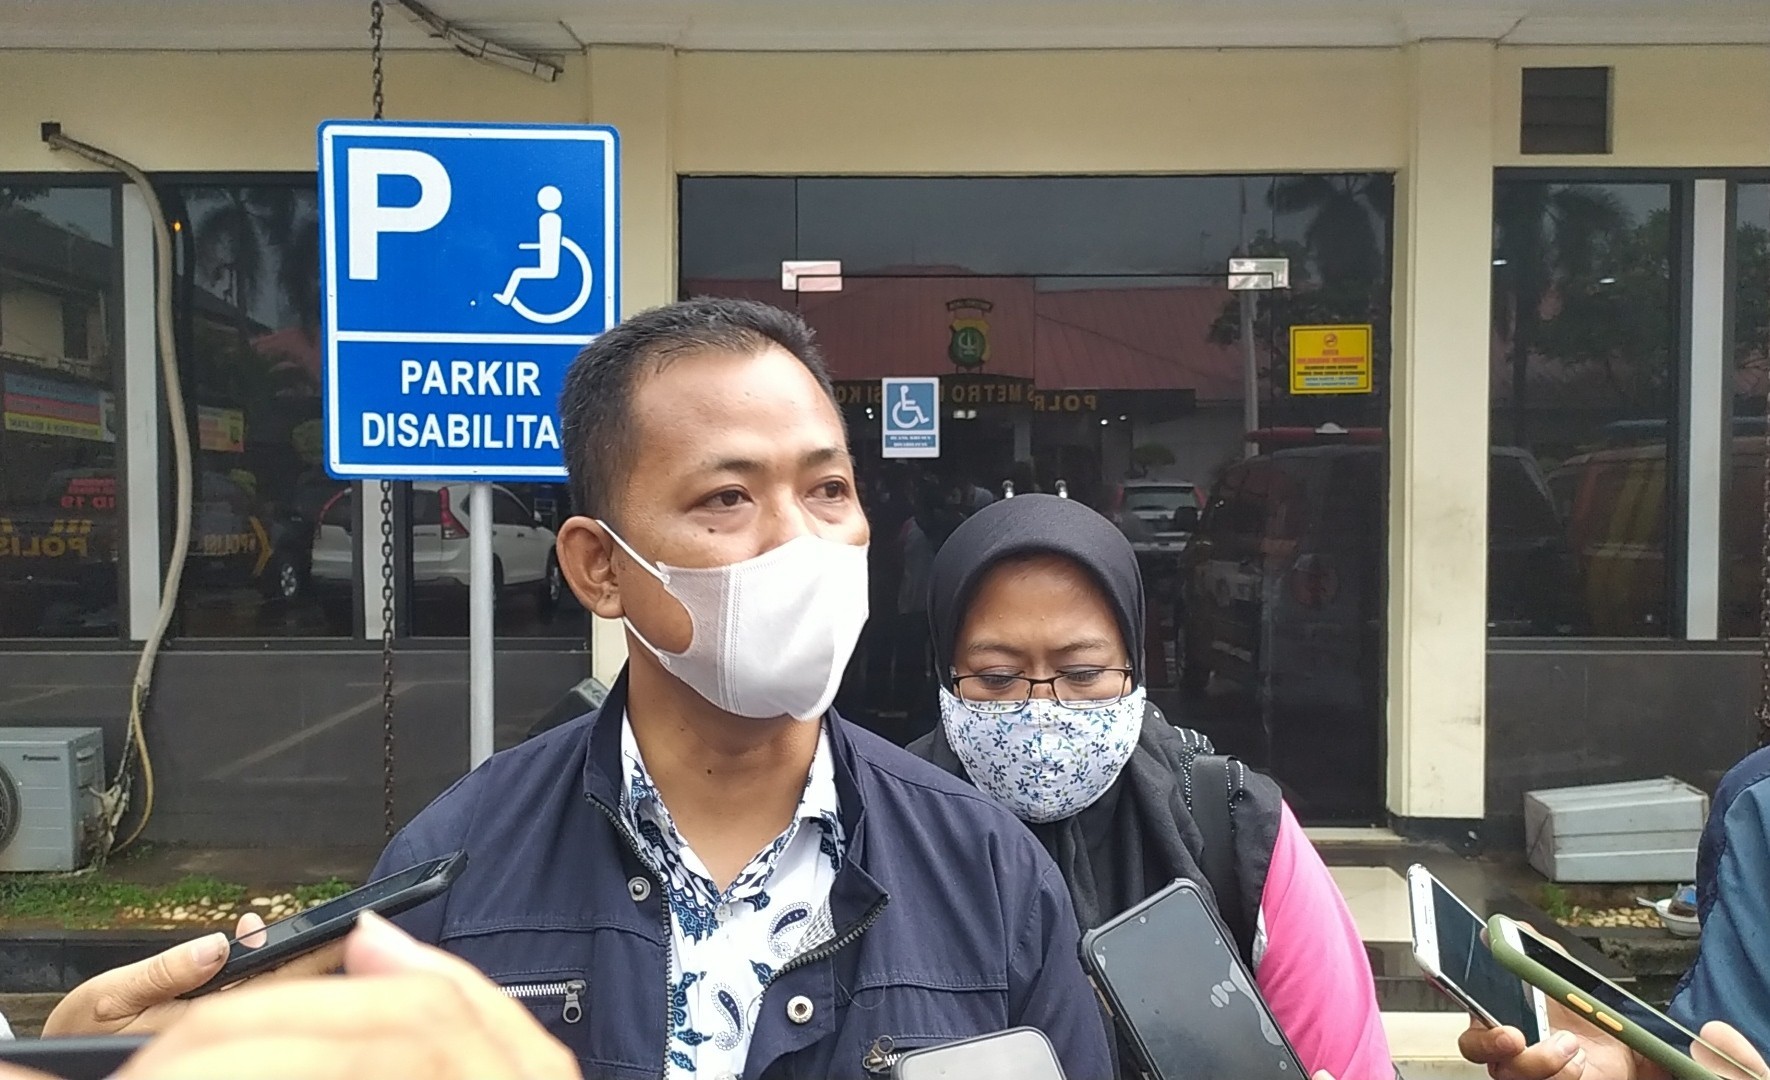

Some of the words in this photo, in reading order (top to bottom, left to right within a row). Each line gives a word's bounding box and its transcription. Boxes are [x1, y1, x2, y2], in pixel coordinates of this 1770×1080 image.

[347, 147, 452, 281] P
[401, 359, 541, 396] PARKIR
[362, 411, 561, 449] DISABILITA
